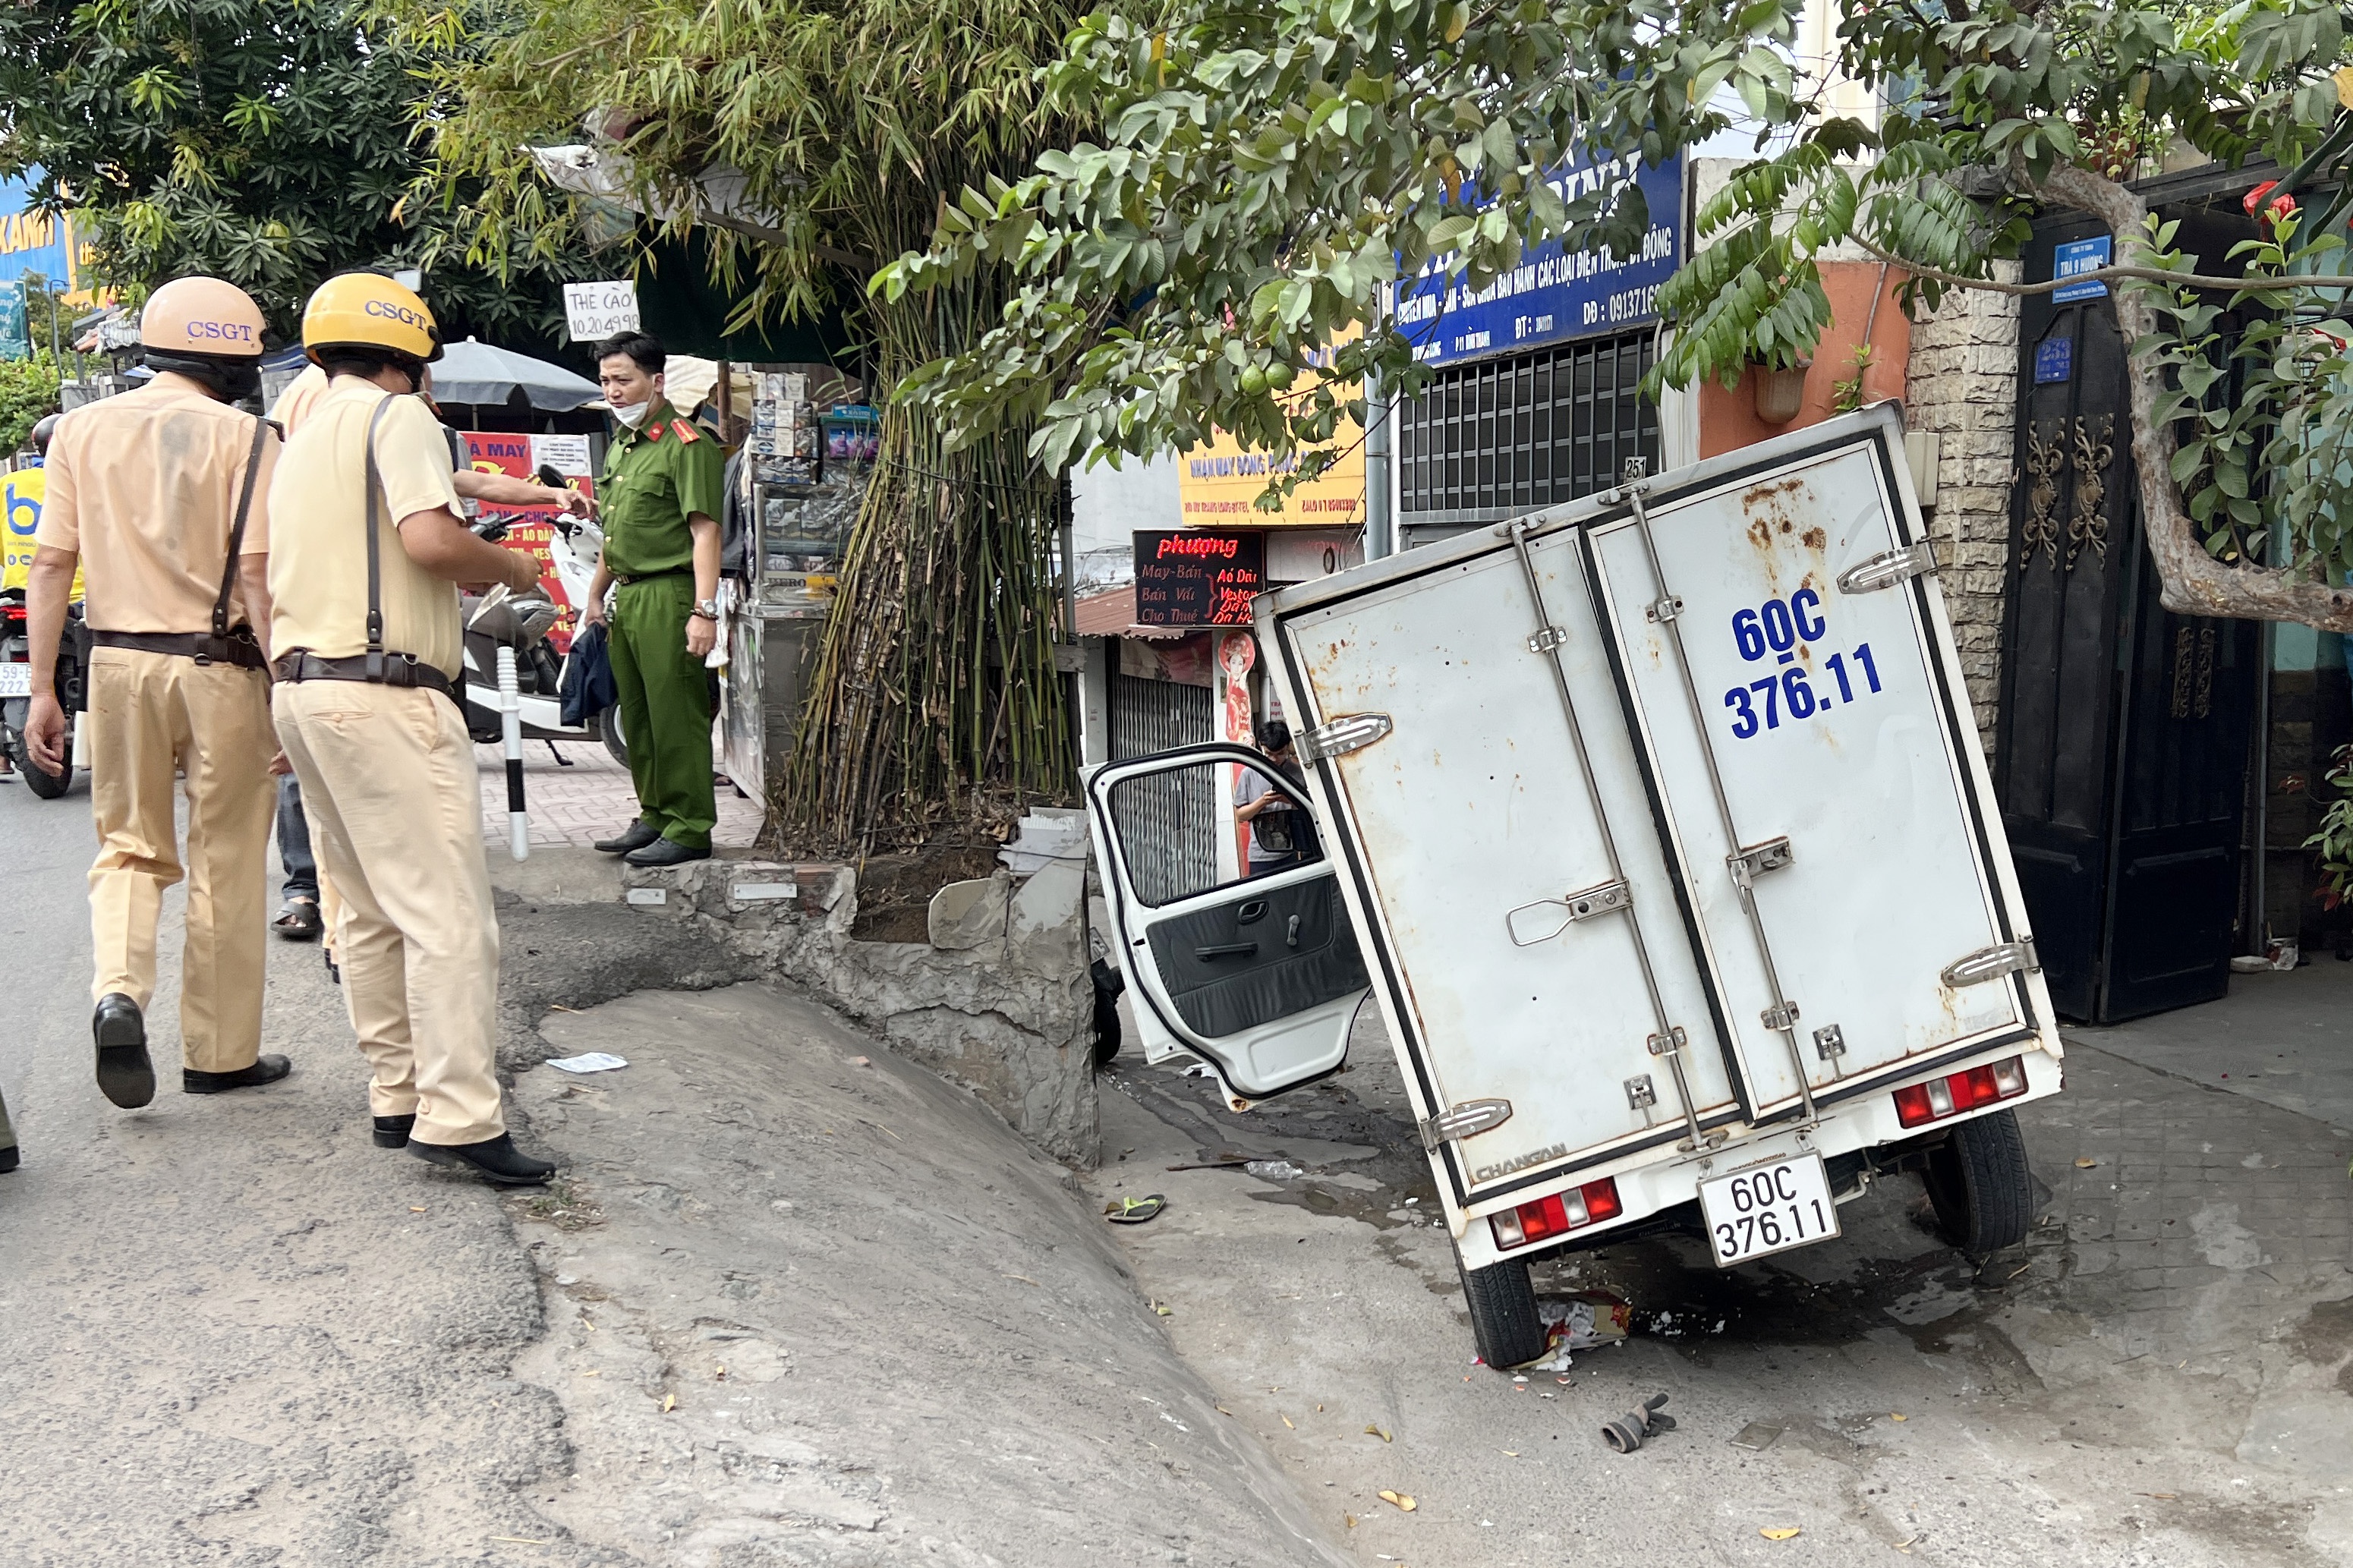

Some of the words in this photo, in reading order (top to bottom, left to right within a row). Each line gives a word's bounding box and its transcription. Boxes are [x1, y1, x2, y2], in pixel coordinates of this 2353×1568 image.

[1538, 253, 1554, 288] CÁC
[1556, 253, 1575, 288] LOẠI
[1643, 223, 1672, 267] ĐỘNG
[364, 300, 427, 331] CSGT
[603, 287, 632, 310] CÀO
[187, 321, 251, 342] CSGT
[487, 443, 527, 458] MAY
[1627, 459, 1646, 479] 251
[1731, 588, 1826, 662] 60C
[1724, 642, 1882, 739] 376.11
[1476, 1141, 1567, 1180] CHANGAN
[1731, 1165, 1797, 1213] 60C
[1715, 1198, 1827, 1258] 376.11
